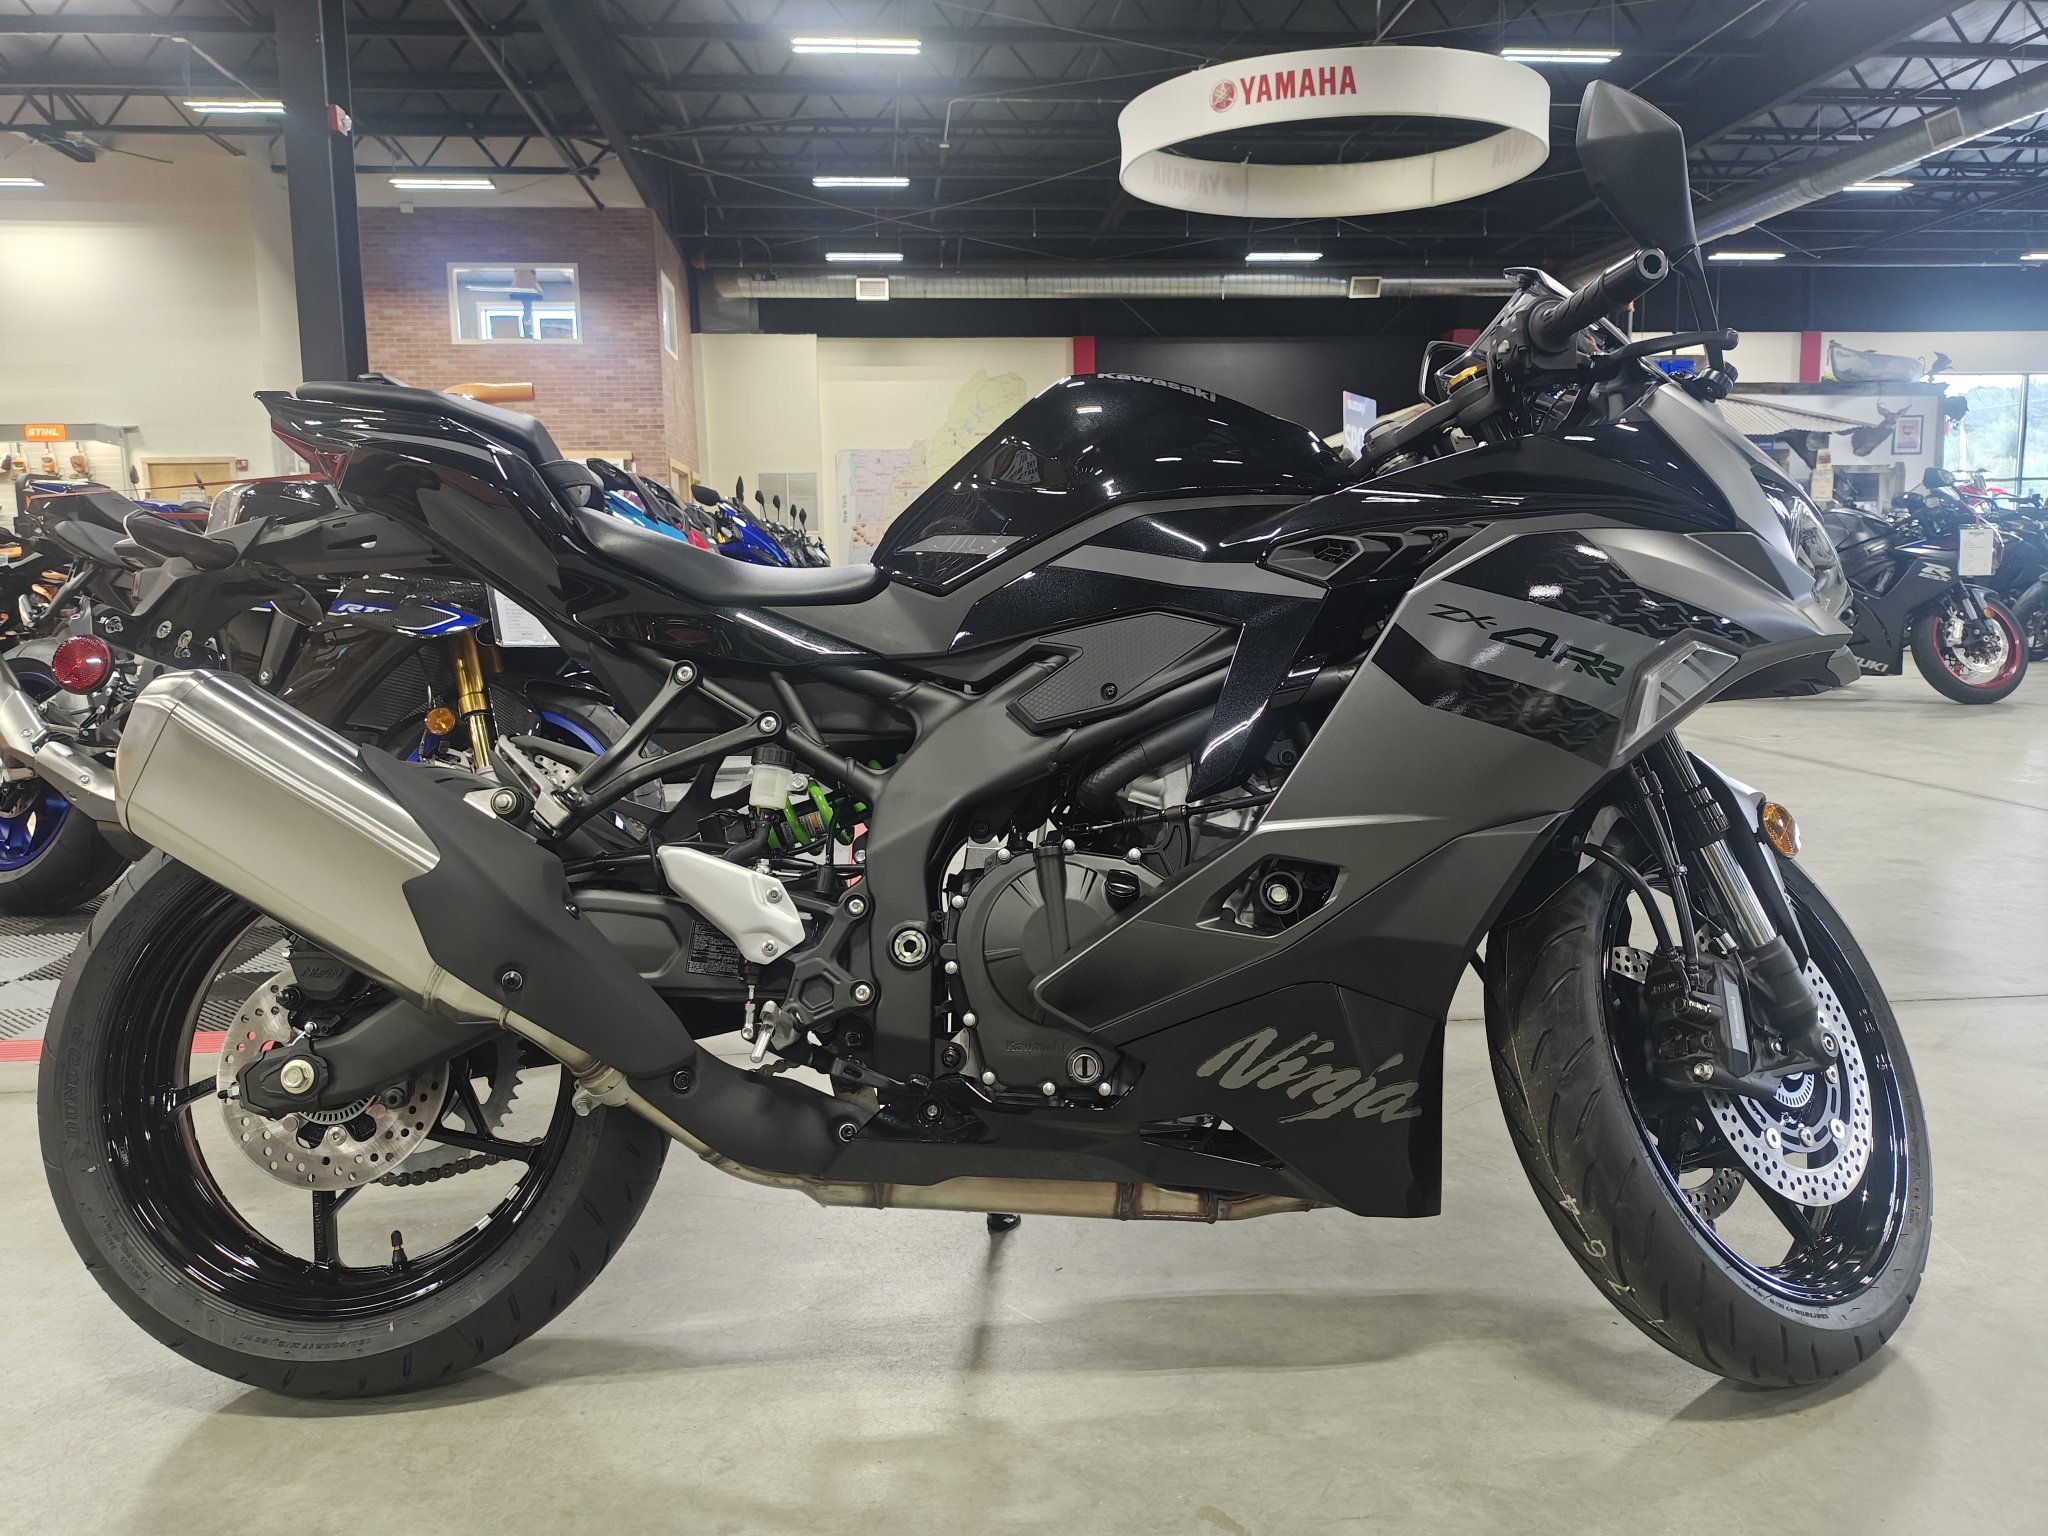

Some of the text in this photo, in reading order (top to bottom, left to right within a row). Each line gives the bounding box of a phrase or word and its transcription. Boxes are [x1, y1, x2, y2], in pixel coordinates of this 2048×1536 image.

[1240, 66, 1357, 106] YAMAHA
[1097, 372, 1217, 403] Kawasaki
[27, 427, 60, 437] STIHL
[1856, 656, 1889, 673] ZUKI
[1196, 1026, 1422, 1123] Ninja
